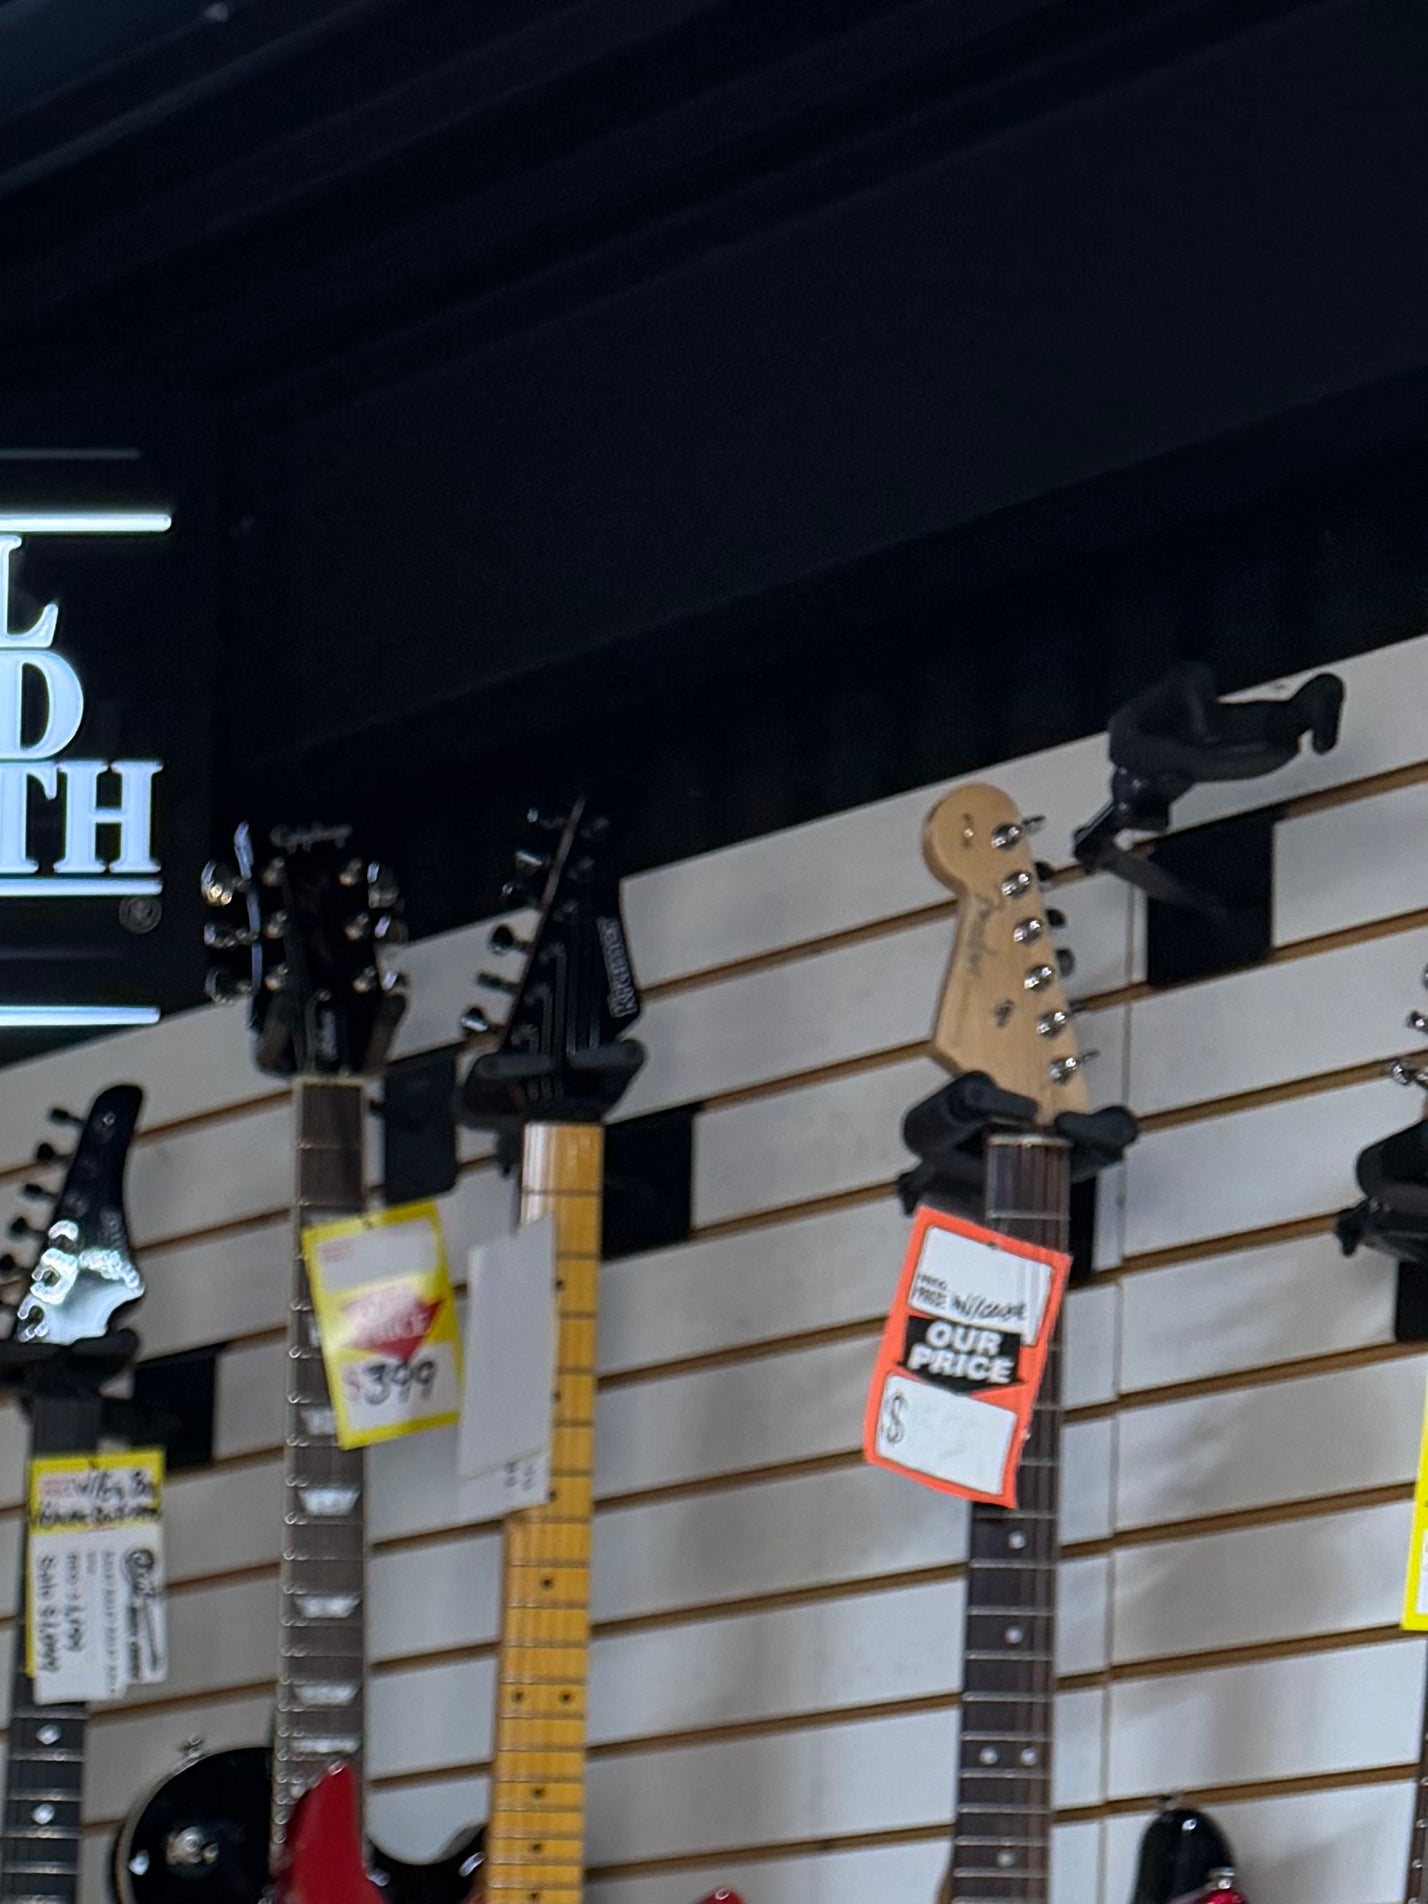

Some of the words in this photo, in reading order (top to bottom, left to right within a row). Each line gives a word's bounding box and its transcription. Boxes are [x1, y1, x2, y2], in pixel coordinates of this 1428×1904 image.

[925, 1321, 1003, 1355] OUR
[363, 1360, 437, 1406] 399
[906, 1343, 1016, 1384] PRICE
